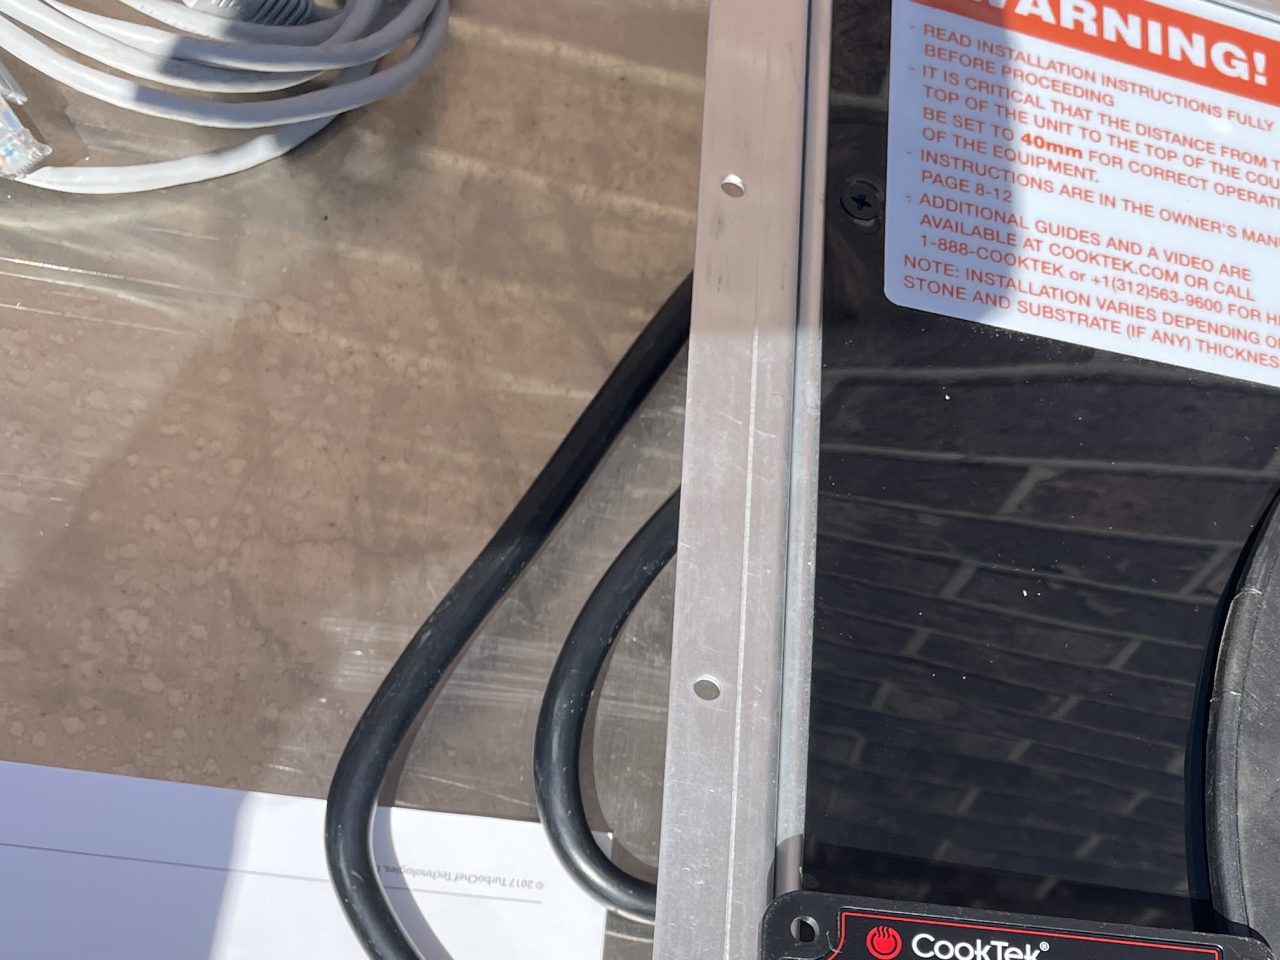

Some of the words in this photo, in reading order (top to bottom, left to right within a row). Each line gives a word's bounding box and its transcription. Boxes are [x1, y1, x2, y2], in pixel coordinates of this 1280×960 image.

[923, 24, 971, 47] READ
[977, 40, 1096, 82] INSTALLATION
[1101, 73, 1222, 118] INSTRUCTIONS
[1226, 110, 1274, 131] FULLY
[924, 44, 995, 74] BEFORE
[1001, 64, 1115, 107] PROCEEDING
[971, 0, 1268, 86] ARNING!
[922, 65, 938, 79] IT
[944, 70, 960, 86] IS
[965, 77, 1046, 109] CRITICAL
[1050, 100, 1093, 121] THAT
[1098, 112, 1130, 132] THE
[1135, 123, 1216, 155] DISTANCE
[1220, 146, 1267, 169] FROM
[922, 127, 946, 143] OF
[952, 135, 987, 154] THE
[993, 144, 1099, 183] EQUIPMENT.
[923, 85, 960, 103] TOP
[965, 97, 989, 112] OF
[994, 104, 1028, 124] THE
[1033, 114, 1074, 135] UNIT
[1078, 126, 1102, 143] TO
[1107, 133, 1140, 153] THE
[1144, 143, 1178, 162] TOP
[1182, 154, 1205, 169] OF
[1208, 161, 1241, 180] THE
[923, 107, 946, 124] BE
[952, 115, 987, 136] SET
[991, 124, 1014, 141] TO
[1020, 133, 1083, 159] 40mm
[1088, 151, 1123, 170] FOR
[1128, 161, 1209, 190] CORRECT
[920, 149, 1054, 193] INSTRUCTIONS
[1059, 185, 1095, 203] ARE
[1099, 193, 1117, 209] IN
[1121, 198, 1154, 217] THE
[1159, 208, 1237, 238] OWNER'S
[921, 169, 970, 193] PAGE
[975, 185, 1013, 202] 8-12
[920, 193, 1029, 230] ADDITIONAL
[1035, 220, 1101, 246] GUIDES
[1106, 236, 1142, 256] AND
[1147, 247, 1159, 260] A
[1163, 250, 1214, 273] VIDEO
[1218, 263, 1252, 282] ARE
[920, 213, 1017, 247] AVAILABLE
[1023, 237, 1043, 253] AT
[1048, 242, 1179, 284] COOKTEK.COM
[1184, 274, 1208, 291] OR
[1213, 281, 1256, 302] CALL
[920, 235, 1064, 278] 1-888-COOKTEK
[1069, 270, 1085, 282] or
[1091, 274, 1223, 314] +1(312)563-9600
[1228, 303, 1261, 322] FOR
[903, 275, 967, 301] STONE
[972, 290, 1011, 310] AND
[1017, 300, 1121, 335] SUBSTRATE
[1126, 324, 1147, 340] (IF
[1151, 330, 1192, 351] ANY)
[904, 254, 960, 279] NOTE:
[965, 267, 1091, 308] INSTALLATION
[1096, 297, 1157, 321] VARIES
[1162, 312, 1261, 345] DEPENDING
[455, 871, 507, 887] TurboChef
[508, 877, 534, 889] 2017
